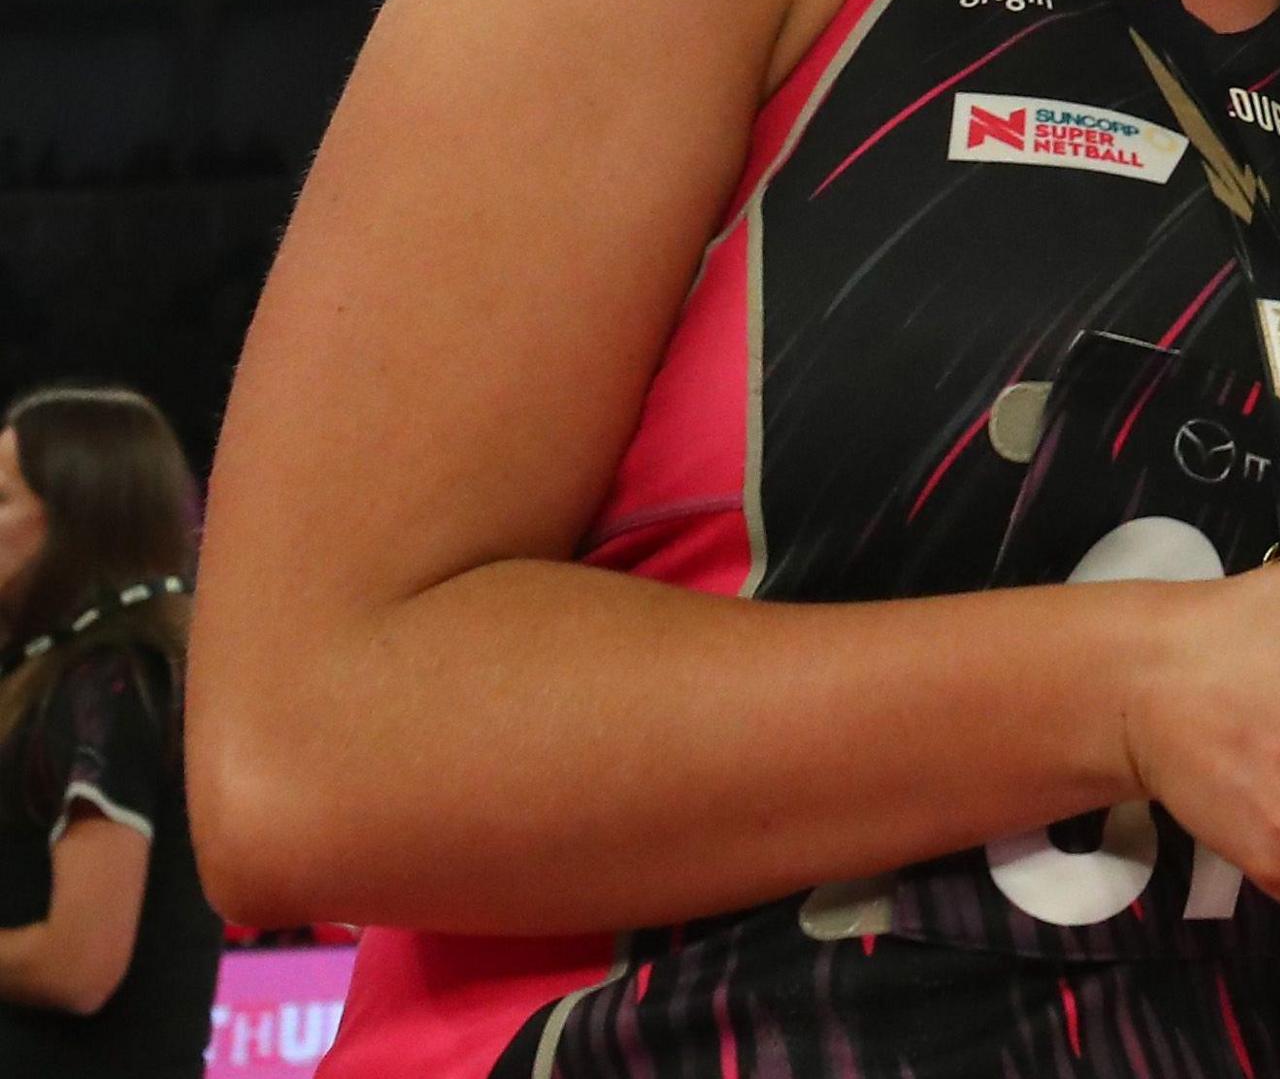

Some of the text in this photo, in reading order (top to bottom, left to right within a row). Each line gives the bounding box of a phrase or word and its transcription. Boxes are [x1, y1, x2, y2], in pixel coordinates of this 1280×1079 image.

[1035, 108, 1140, 137] SUNCORP
[1035, 123, 1115, 147] SUPER
[1033, 139, 1144, 168] NETBALL
